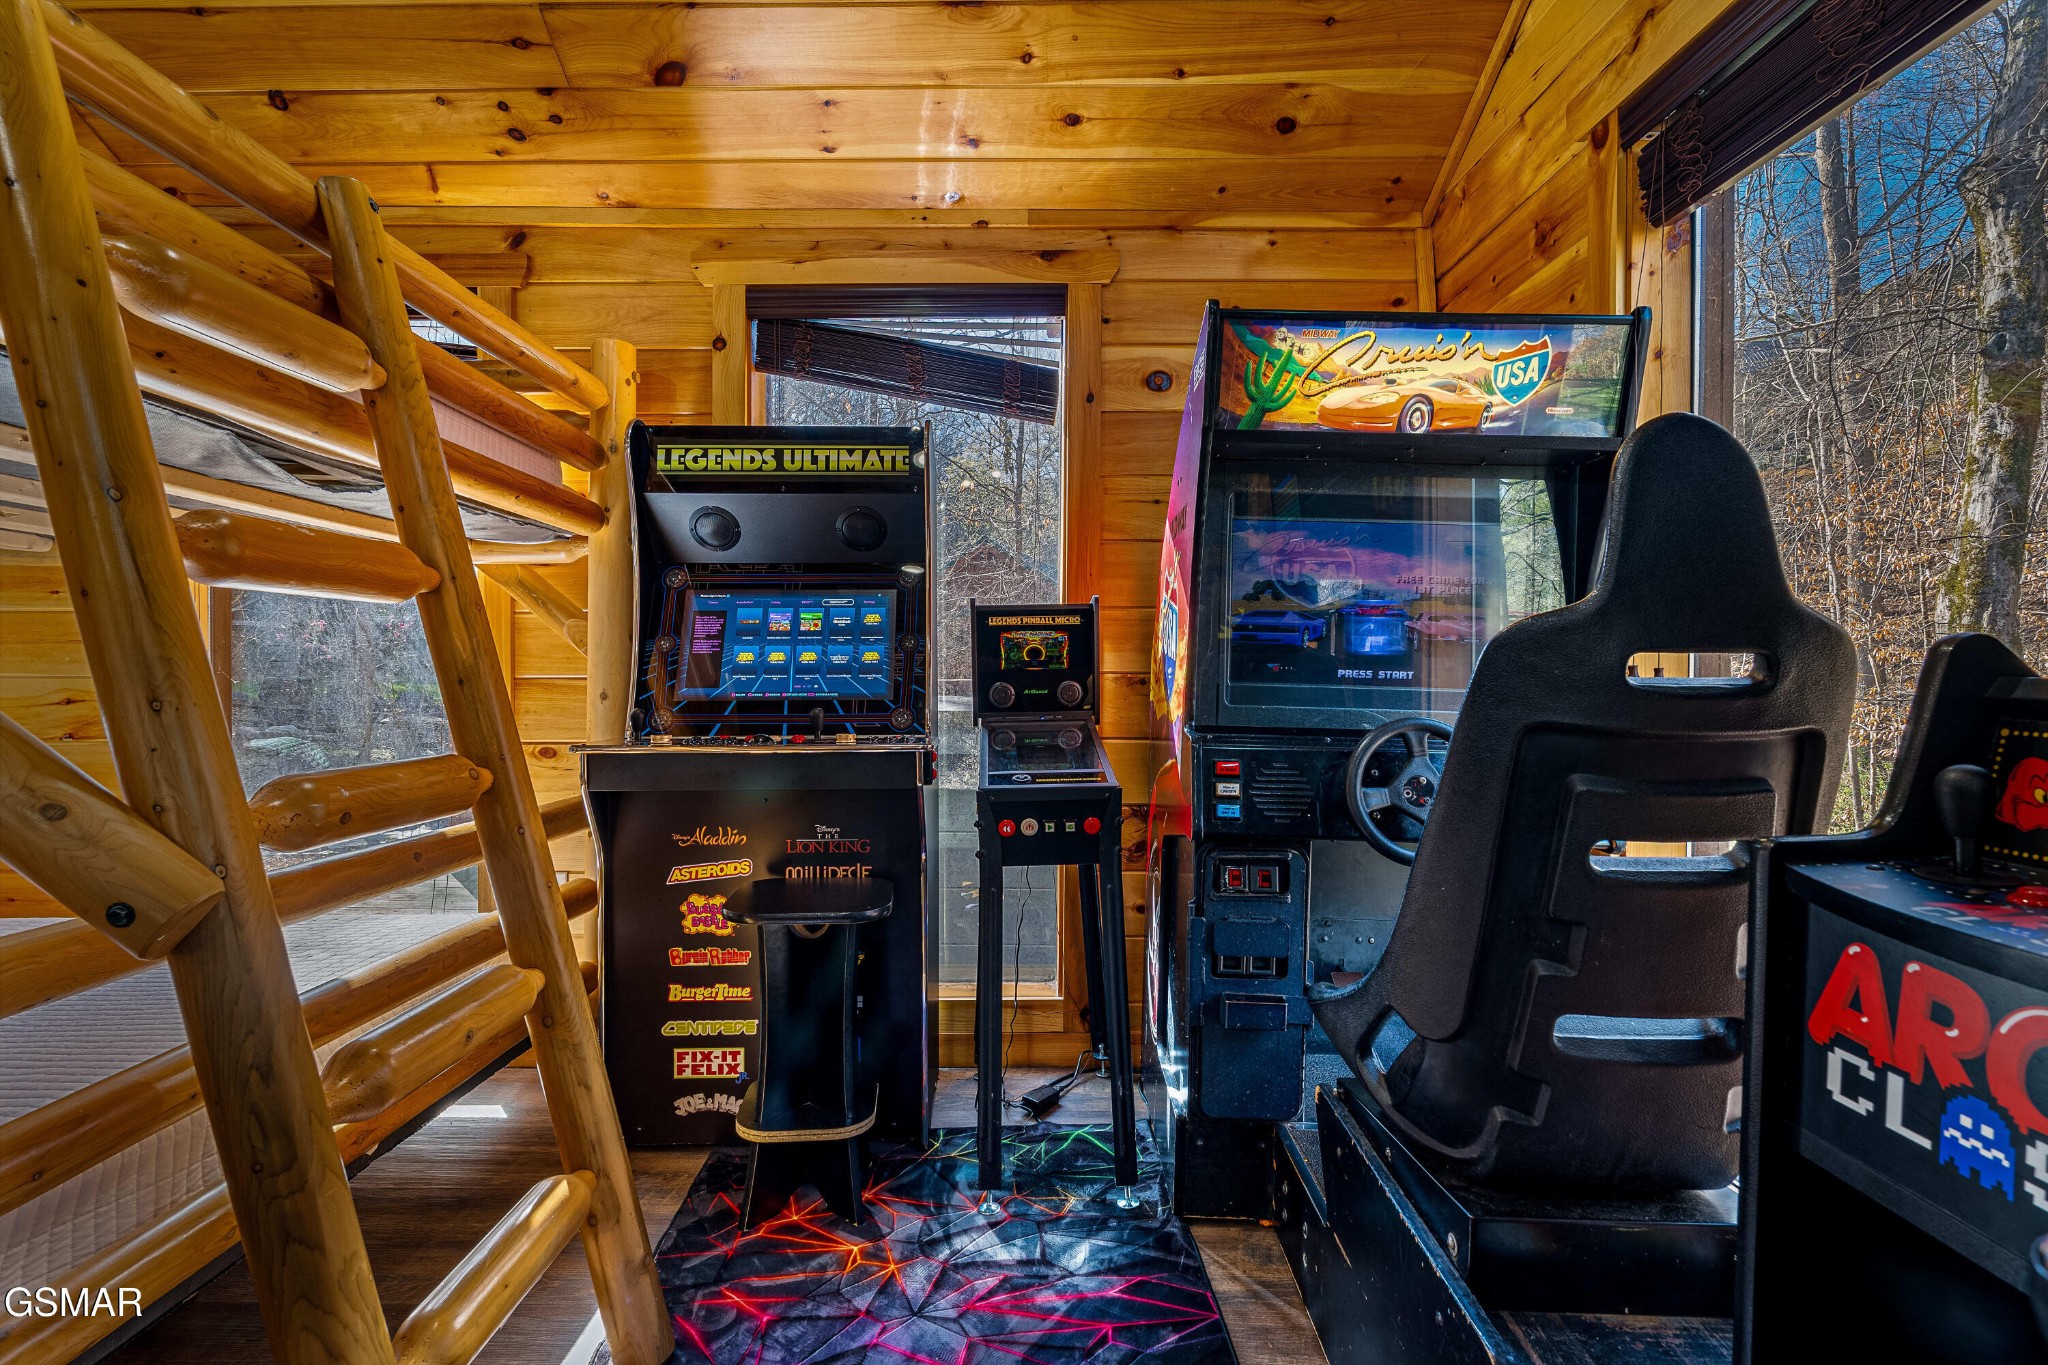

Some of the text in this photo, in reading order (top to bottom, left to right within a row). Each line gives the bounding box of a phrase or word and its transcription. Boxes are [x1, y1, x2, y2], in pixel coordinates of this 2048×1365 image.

[1301, 329, 1340, 338] MIDWAY
[1297, 329, 1541, 398] Cruis'n USA
[657, 448, 909, 472] LEGENDS ULTIMATE
[1396, 575, 1423, 585] FREE
[1428, 575, 1462, 585] GAME
[1439, 586, 1472, 596] PLACE
[989, 615, 1081, 625] LEGENDS PINBALL MICRO
[1338, 669, 1414, 680] PRESS START
[678, 825, 747, 847] Aladdin
[786, 839, 871, 853] LION KING
[670, 860, 751, 882] ASTEROIDS
[691, 915, 729, 930] BOBBLE
[709, 947, 751, 965] Rubber
[668, 983, 751, 1001] BurgerTime
[661, 1020, 757, 1036] CENTIPEDE
[676, 1050, 741, 1063] FIX-IT
[676, 1063, 740, 1076] FELIX
